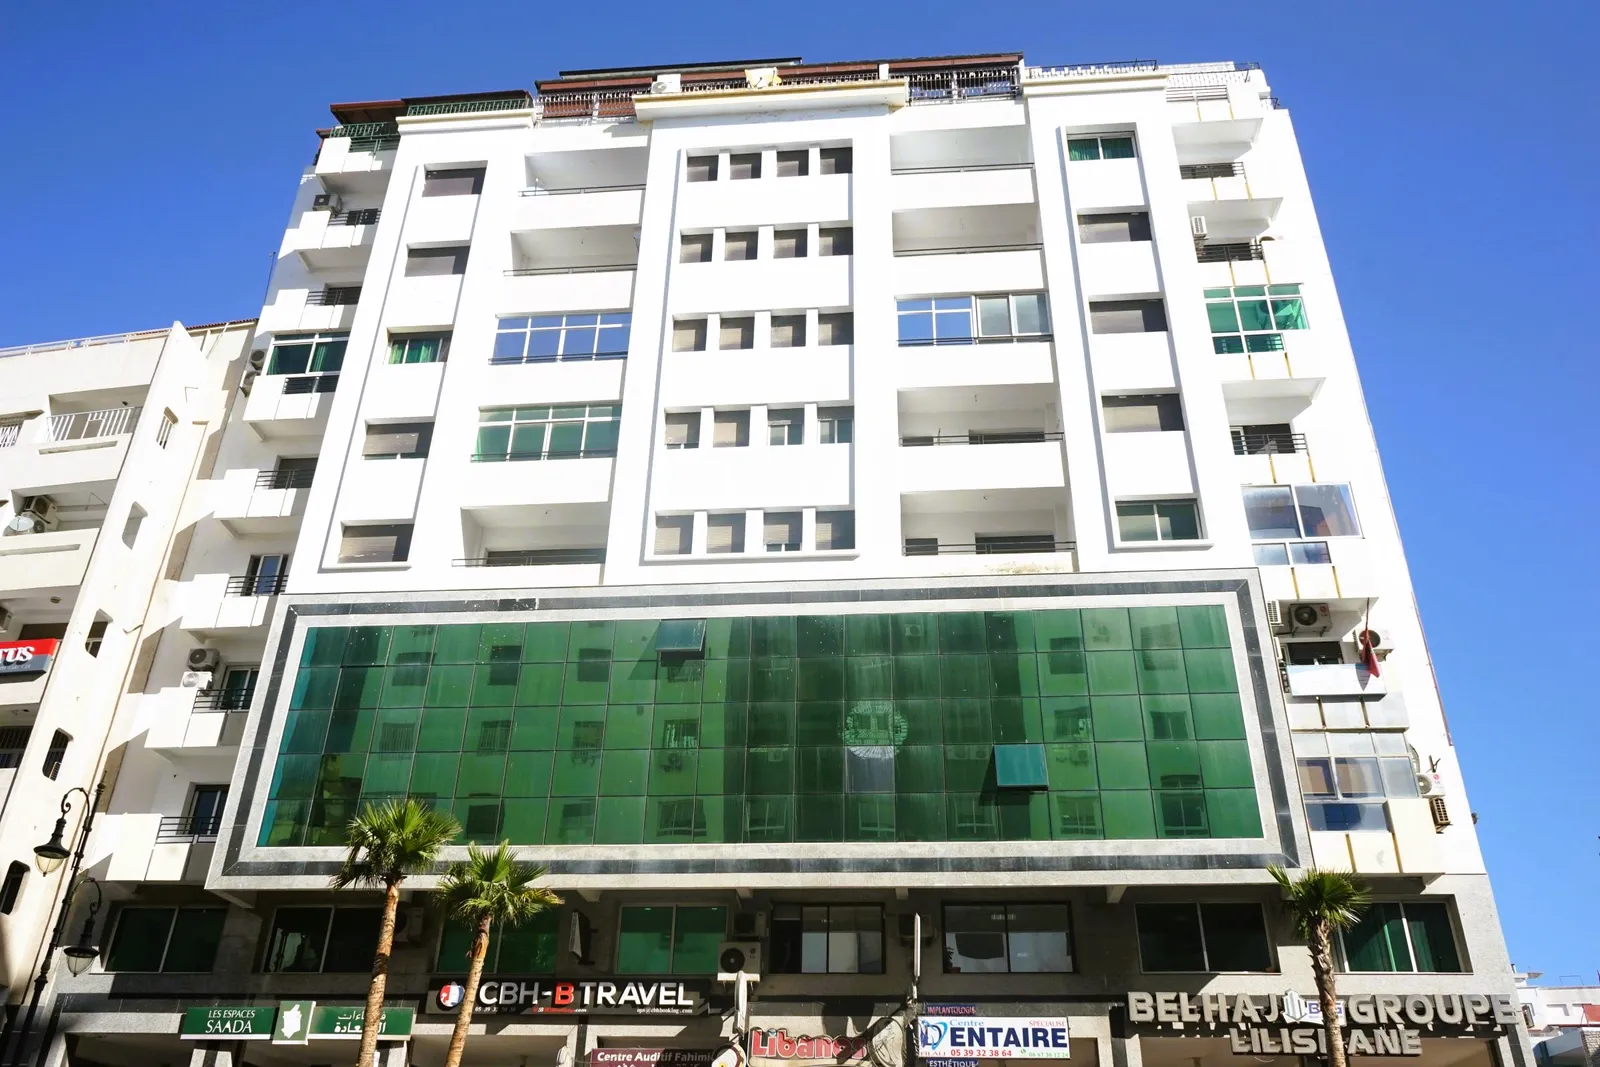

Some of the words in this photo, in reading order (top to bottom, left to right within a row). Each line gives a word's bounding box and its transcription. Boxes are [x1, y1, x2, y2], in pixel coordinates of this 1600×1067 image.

[579, 981, 694, 1006] TRAVEL
[208, 1009, 221, 1018] LES
[223, 1009, 256, 1018] ESPACES
[1127, 991, 1279, 1023] BELHAJ
[1347, 993, 1518, 1025] GROUPE
[205, 1020, 252, 1033] SAADA
[950, 1019, 984, 1027] Centre
[597, 1051, 632, 1062] Centre
[634, 1051, 673, 1062] Auditif
[950, 1049, 961, 1057] 05
[963, 1049, 974, 1057] 39
[976, 1049, 987, 1057] 32
[989, 1049, 1000, 1057] 38
[1002, 1049, 1012, 1057] 64
